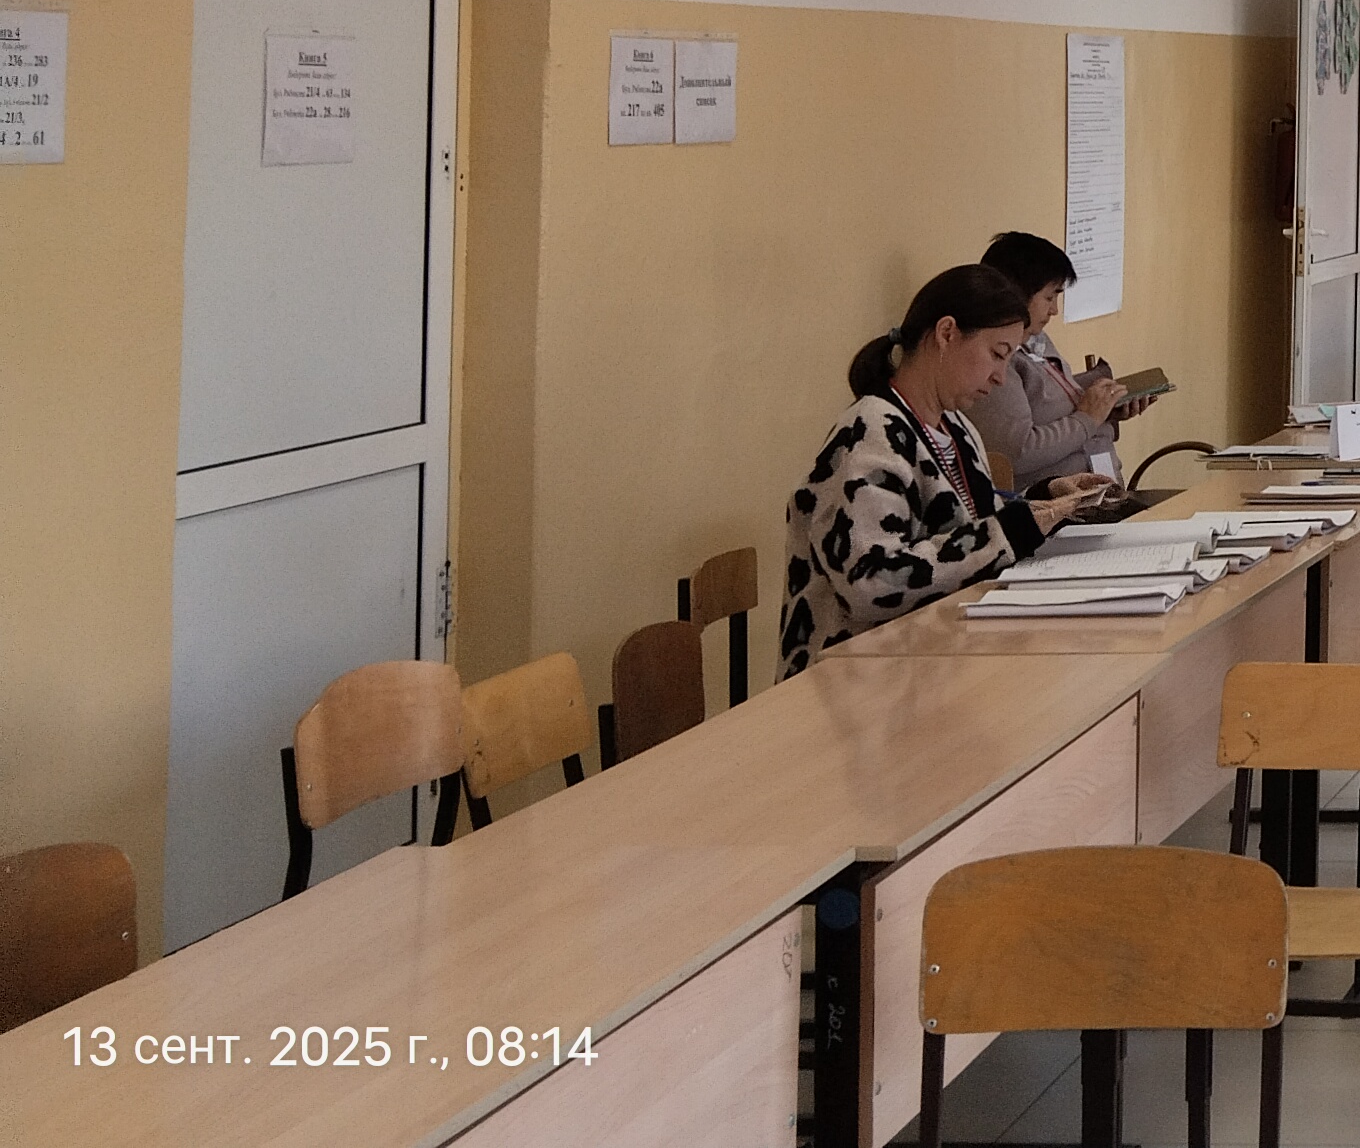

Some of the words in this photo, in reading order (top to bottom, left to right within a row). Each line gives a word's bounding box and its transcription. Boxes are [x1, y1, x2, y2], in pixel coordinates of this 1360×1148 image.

[28, 73, 39, 88] 19
[679, 75, 732, 89] Дополнительный
[32, 93, 49, 106] 21/2
[627, 103, 640, 117] 217
[15, 131, 21, 146] 2
[32, 130, 45, 146] 61
